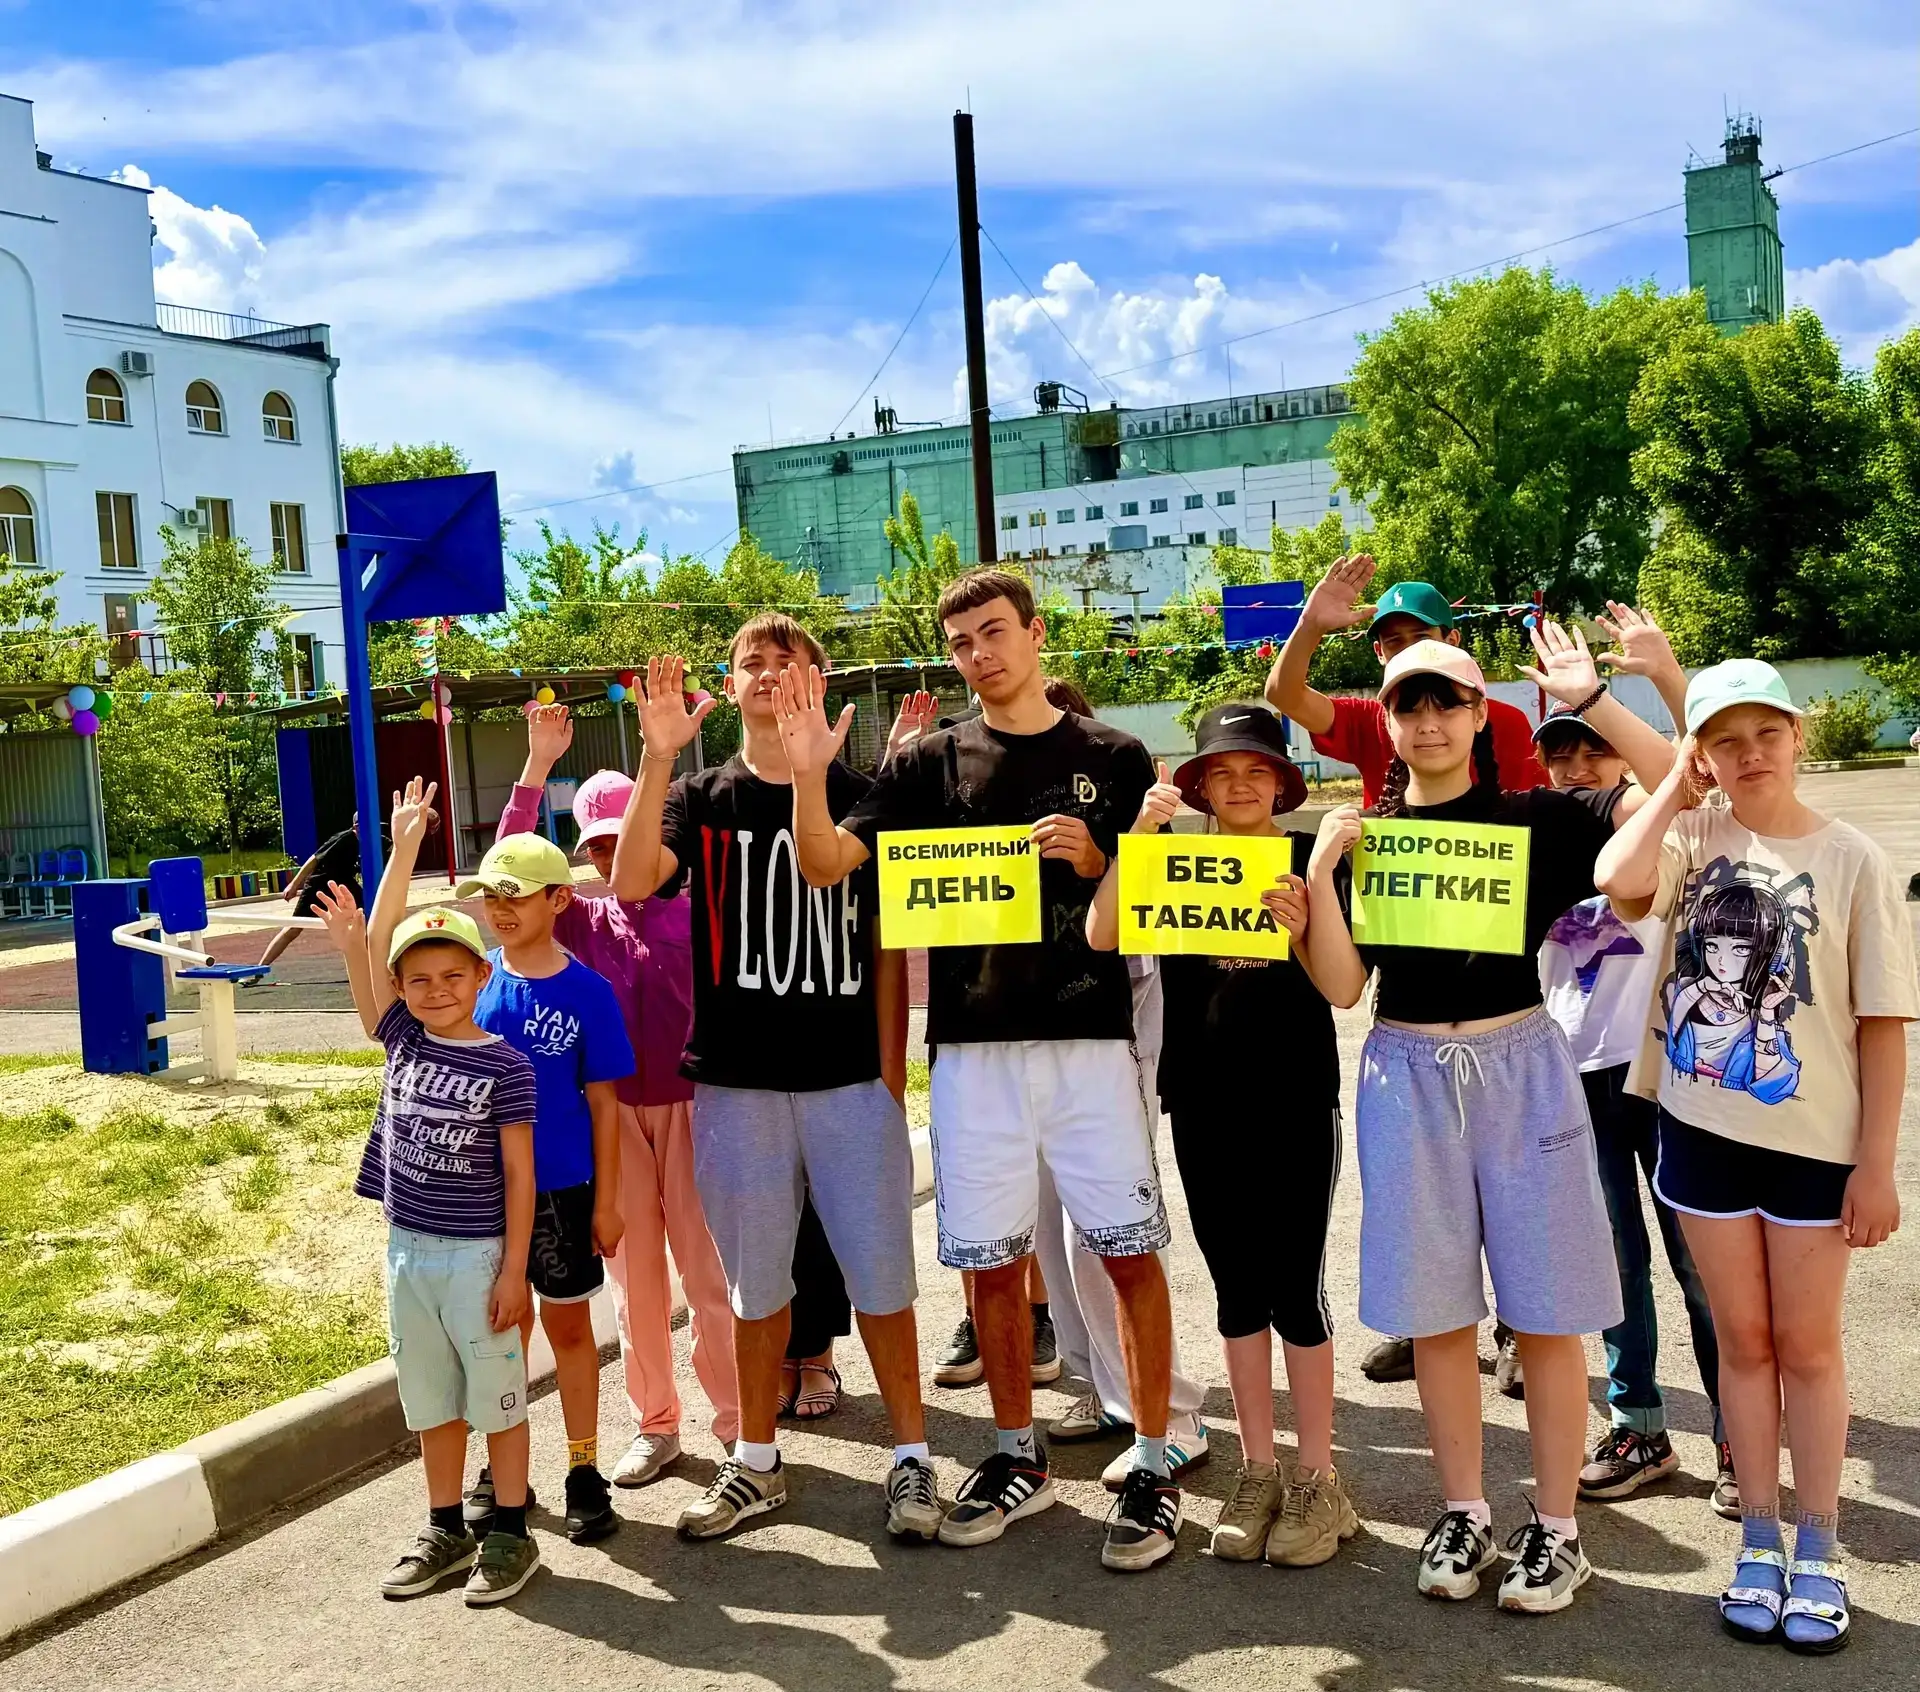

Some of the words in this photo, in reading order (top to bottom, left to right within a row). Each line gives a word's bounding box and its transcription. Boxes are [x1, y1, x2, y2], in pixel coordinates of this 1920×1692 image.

[888, 837, 1030, 860] ВСЕМИРНЫЙ
[1363, 834, 1514, 860] ЗДОРОВЫЕ
[1166, 855, 1243, 885] БЕЗ
[906, 875, 1015, 910] ДЕНЬ
[1361, 871, 1511, 905] ЛЕГКИЕ
[700, 824, 862, 996] VLONE
[1131, 904, 1279, 934] ТАБАКА
[523, 1019, 578, 1047] RIDE
[534, 1003, 580, 1034] VAN
[408, 1115, 479, 1153] Lodge
[388, 1156, 428, 1184] ontana
[393, 1139, 473, 1174] MOUNTAINS
